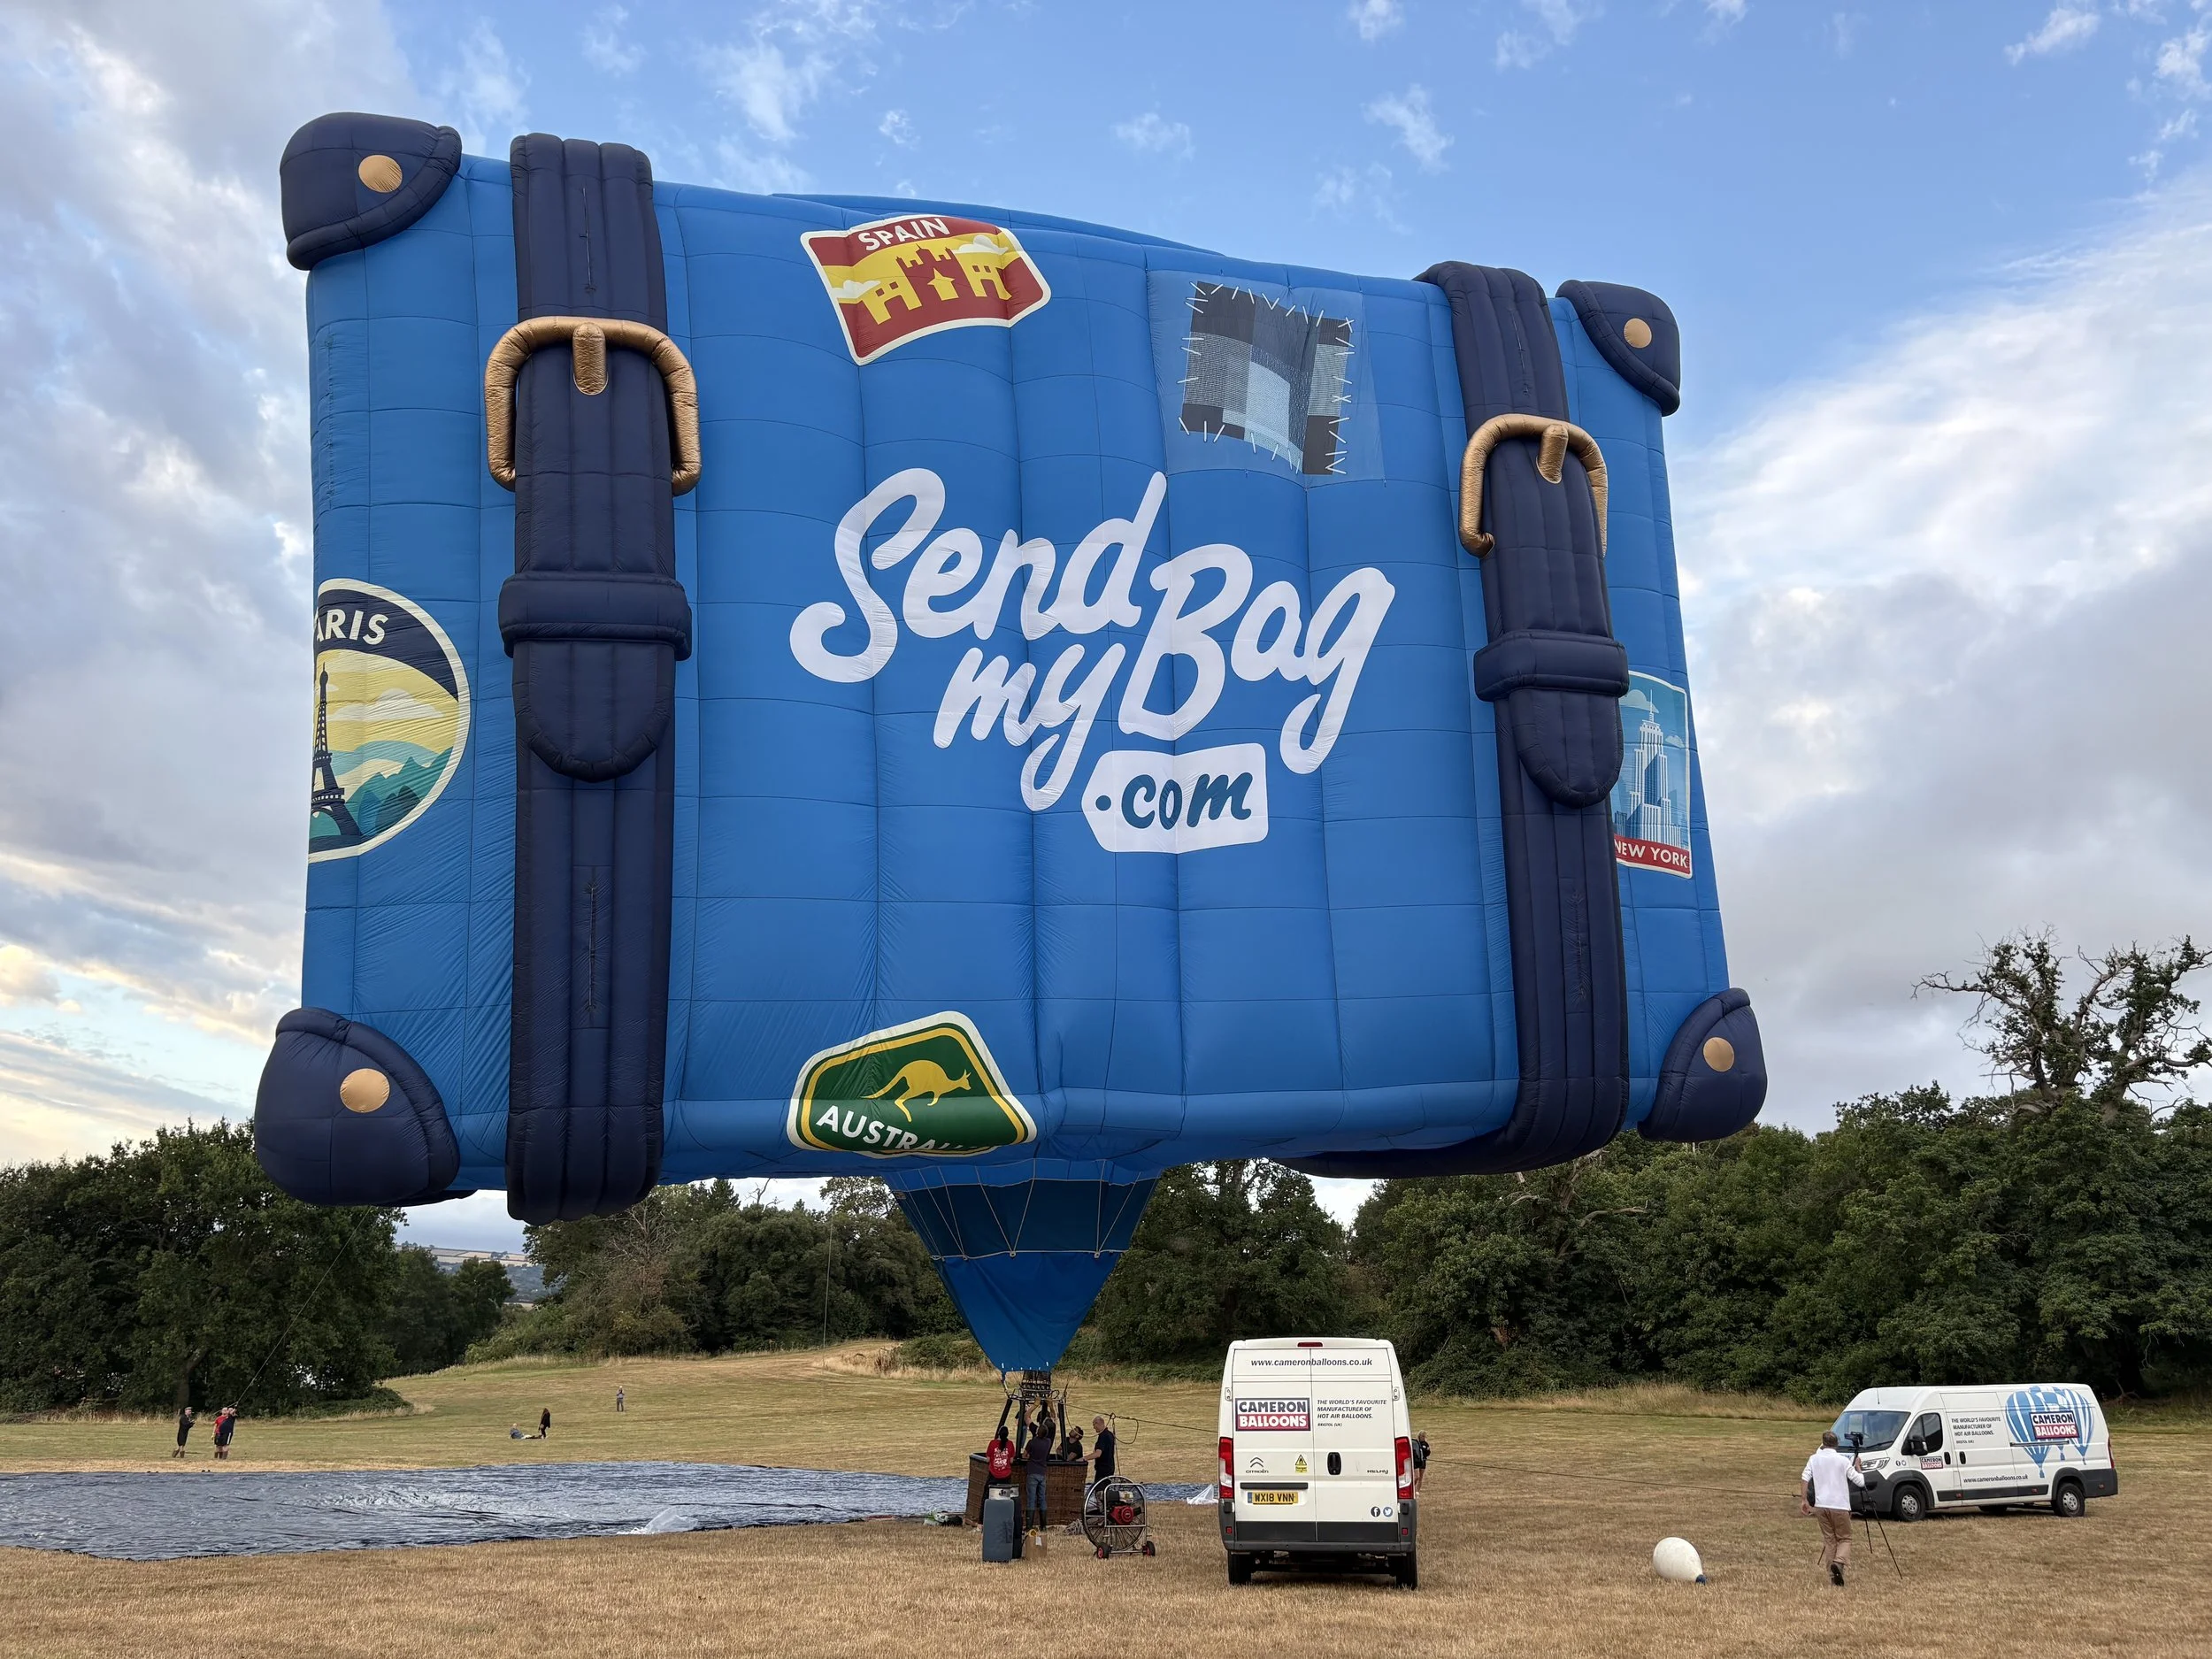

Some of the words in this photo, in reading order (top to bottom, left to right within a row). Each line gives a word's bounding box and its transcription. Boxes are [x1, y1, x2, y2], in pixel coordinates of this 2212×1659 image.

[857, 218, 950, 251] SPAIN
[789, 467, 1167, 683] Send
[933, 642, 1126, 811] my
[1118, 543, 1396, 774] Bag
[1095, 772, 1253, 830] .com
[1614, 839, 1646, 858] NEW
[1650, 847, 1687, 869] YORK
[816, 1105, 978, 1150] AUSTRA
[1250, 1357, 1373, 1366] www.cameronballoons.co.uk
[1239, 1402, 1307, 1413] CAMERON
[1239, 1416, 1307, 1427] BALLOONS
[2032, 1414, 2074, 1425] CAMERON
[2035, 1425, 2077, 1436] BALLOONS
[1963, 1473, 2029, 1483] www.cameronballoons.co.uk
[1255, 1493, 1275, 1502] WX18
[1277, 1493, 1294, 1502] VNN
